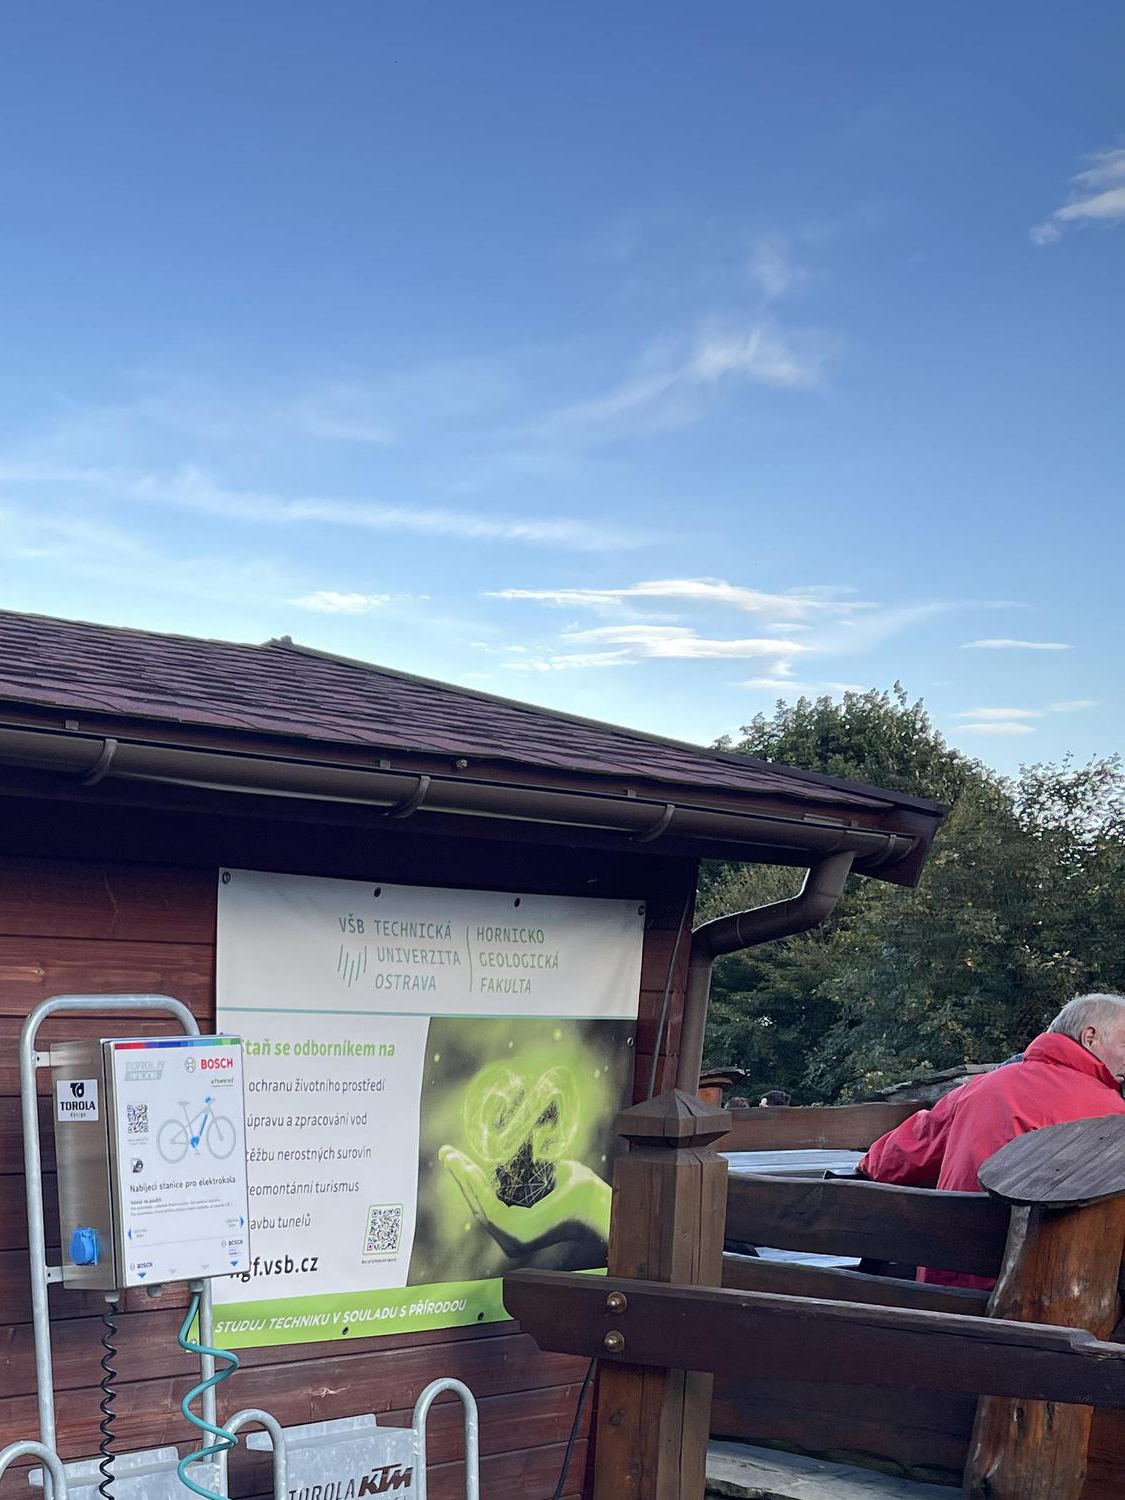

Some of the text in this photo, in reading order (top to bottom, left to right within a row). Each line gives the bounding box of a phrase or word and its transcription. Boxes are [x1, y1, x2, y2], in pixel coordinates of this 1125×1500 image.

[338, 913, 452, 940] VŠB TECHNICKÁ
[477, 926, 545, 944] HORNICKO
[377, 946, 461, 965] UNIVERZITA
[479, 951, 560, 969] GEOLOGICKÁ
[375, 973, 436, 991] OSTRAVA
[480, 977, 532, 994] FAKULTA
[242, 1038, 395, 1057] taň se odborníkem na
[200, 1058, 233, 1070] BOSCH
[249, 1078, 386, 1094] ochranu životního prostředí
[60, 1100, 96, 1111] TOROLA
[246, 1112, 367, 1129] úpravu a zpracování vod
[277, 1147, 335, 1163] nerostných
[337, 1146, 371, 1160] surovin
[159, 1180, 183, 1190] stanice
[185, 1180, 197, 1189] pro
[198, 1176, 236, 1186] elektrokola
[248, 1181, 360, 1196] eomontánní turismus
[249, 1216, 275, 1230] avbu
[277, 1213, 311, 1229] tunelů
[230, 1255, 319, 1283] f.vsb.cz
[214, 1299, 468, 1333] STUDUJ TECHNIKU V SOULADU S PŘÍRODOU
[358, 1463, 414, 1498] KTM
